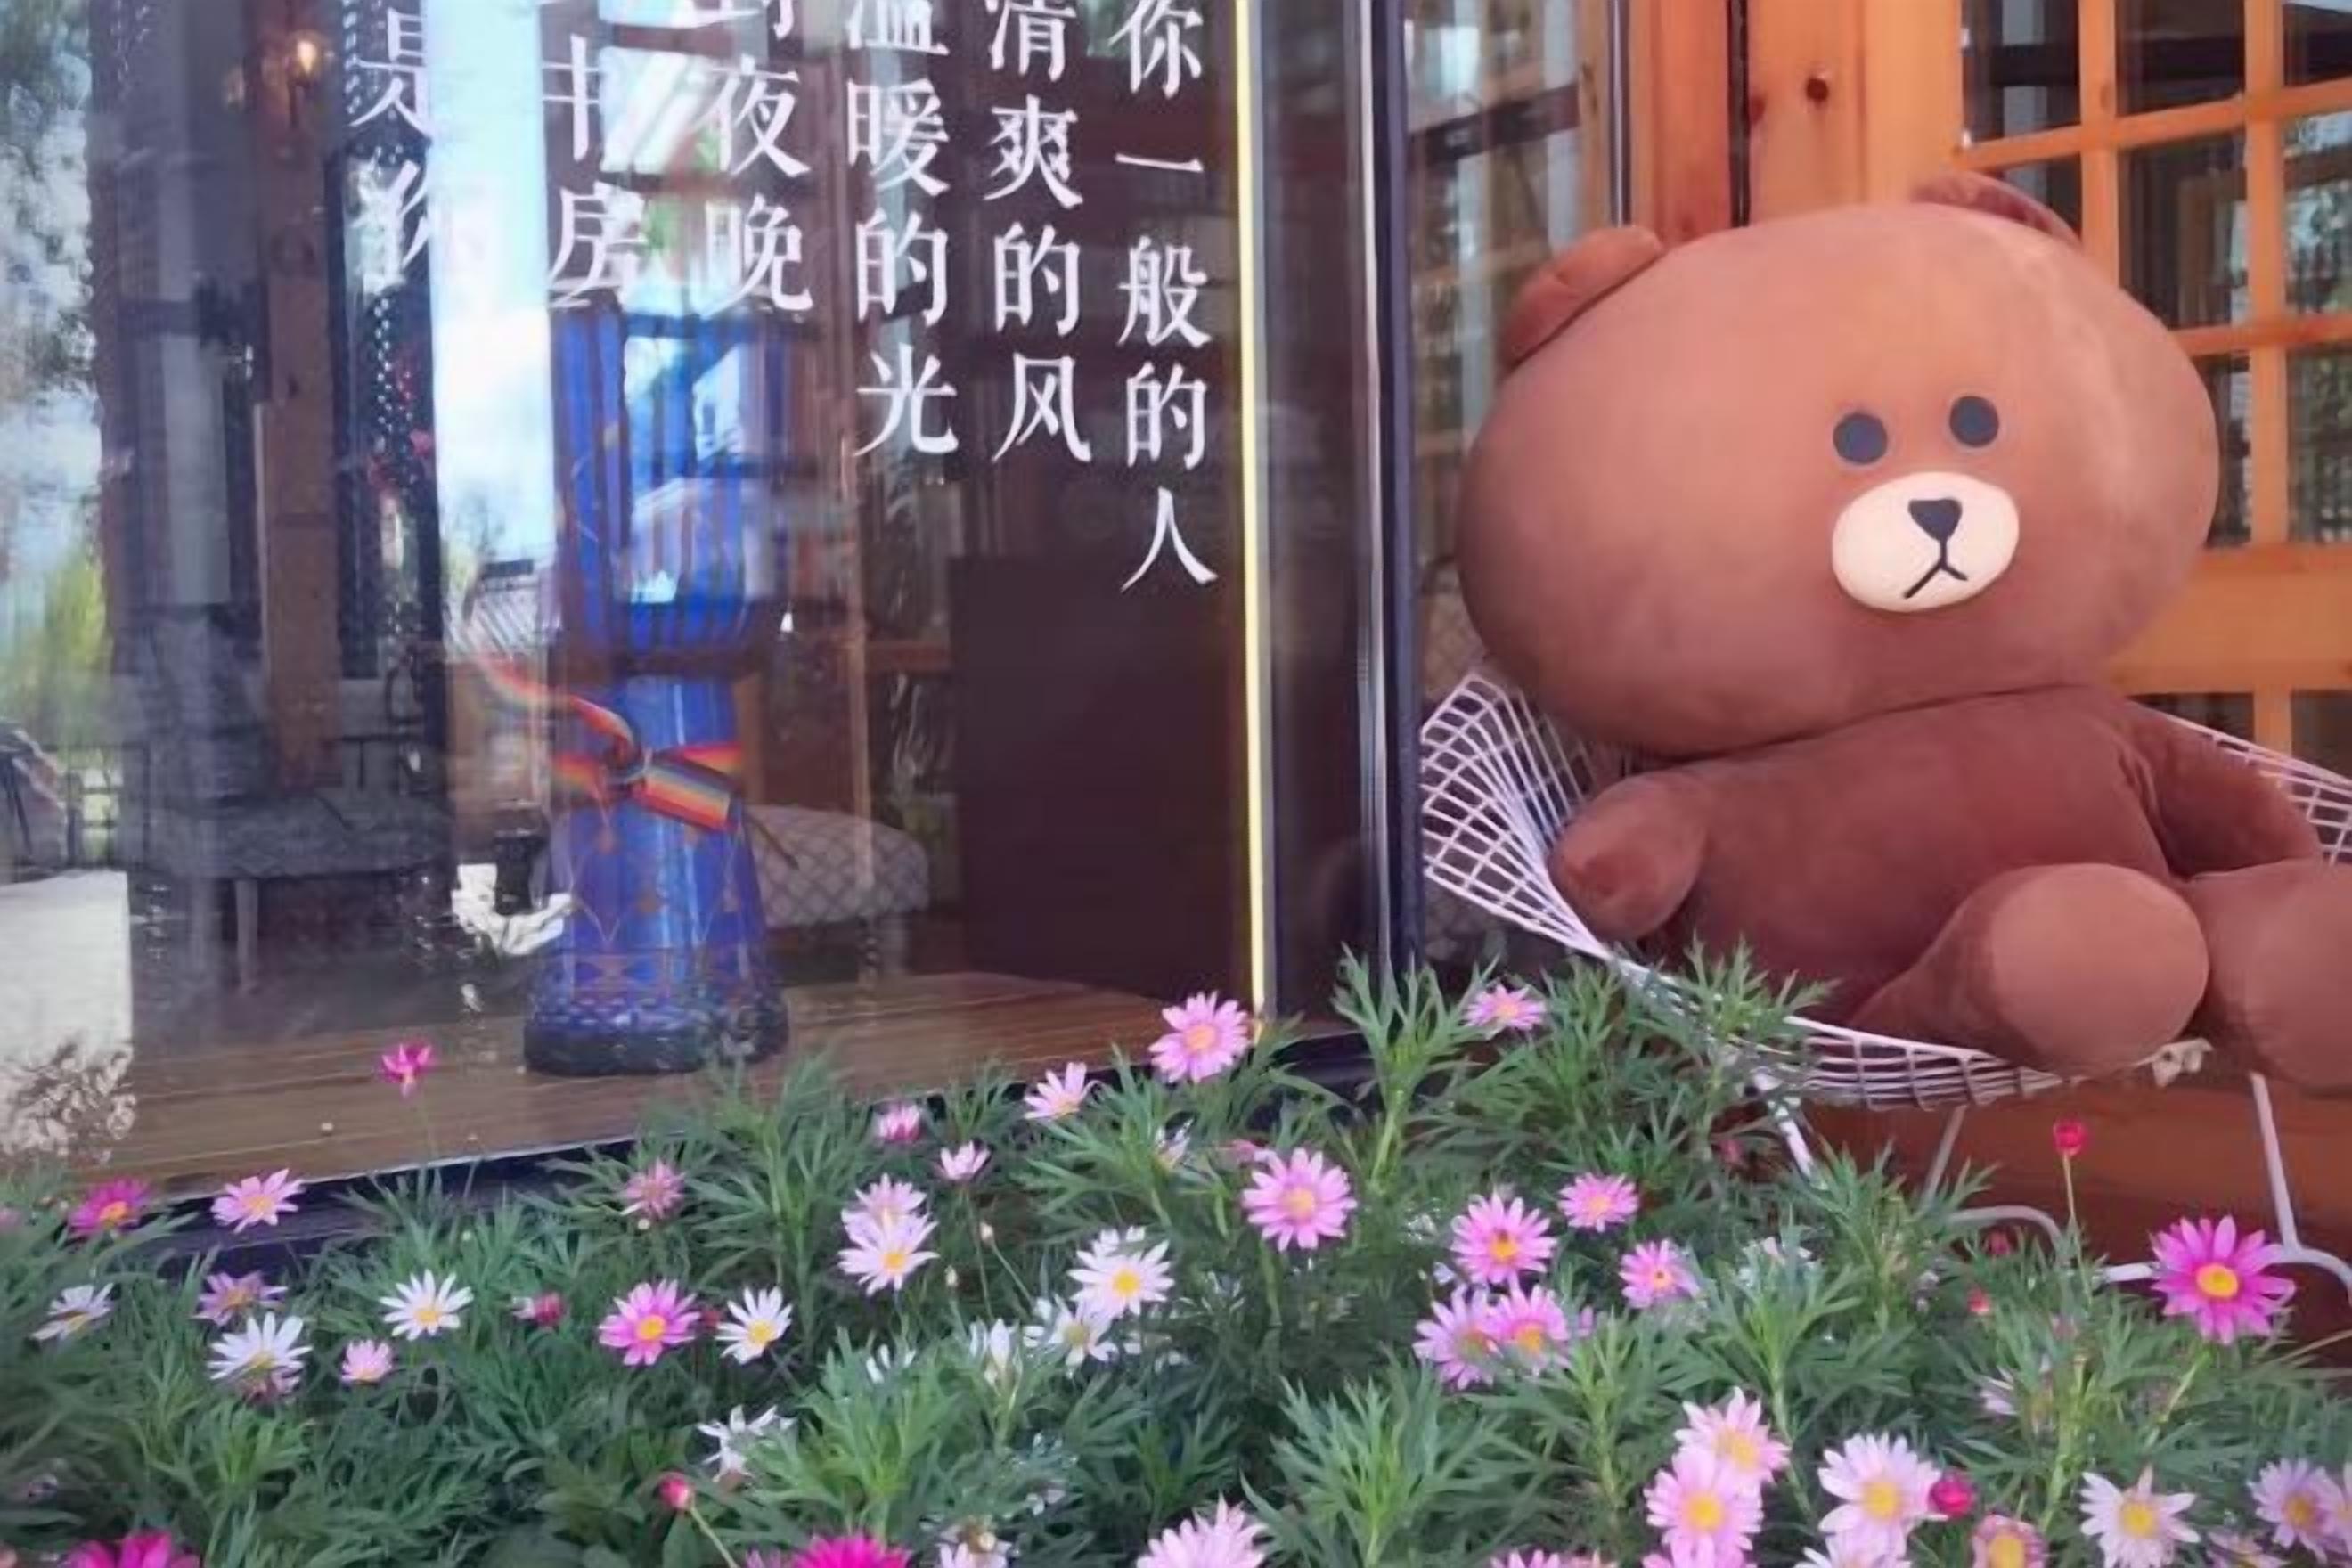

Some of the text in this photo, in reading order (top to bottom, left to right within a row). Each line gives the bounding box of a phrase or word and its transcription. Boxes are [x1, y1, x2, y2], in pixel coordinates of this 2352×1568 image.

[984, 0, 1091, 462] 清爽的风
[1107, 0, 1217, 592] 你一般的人
